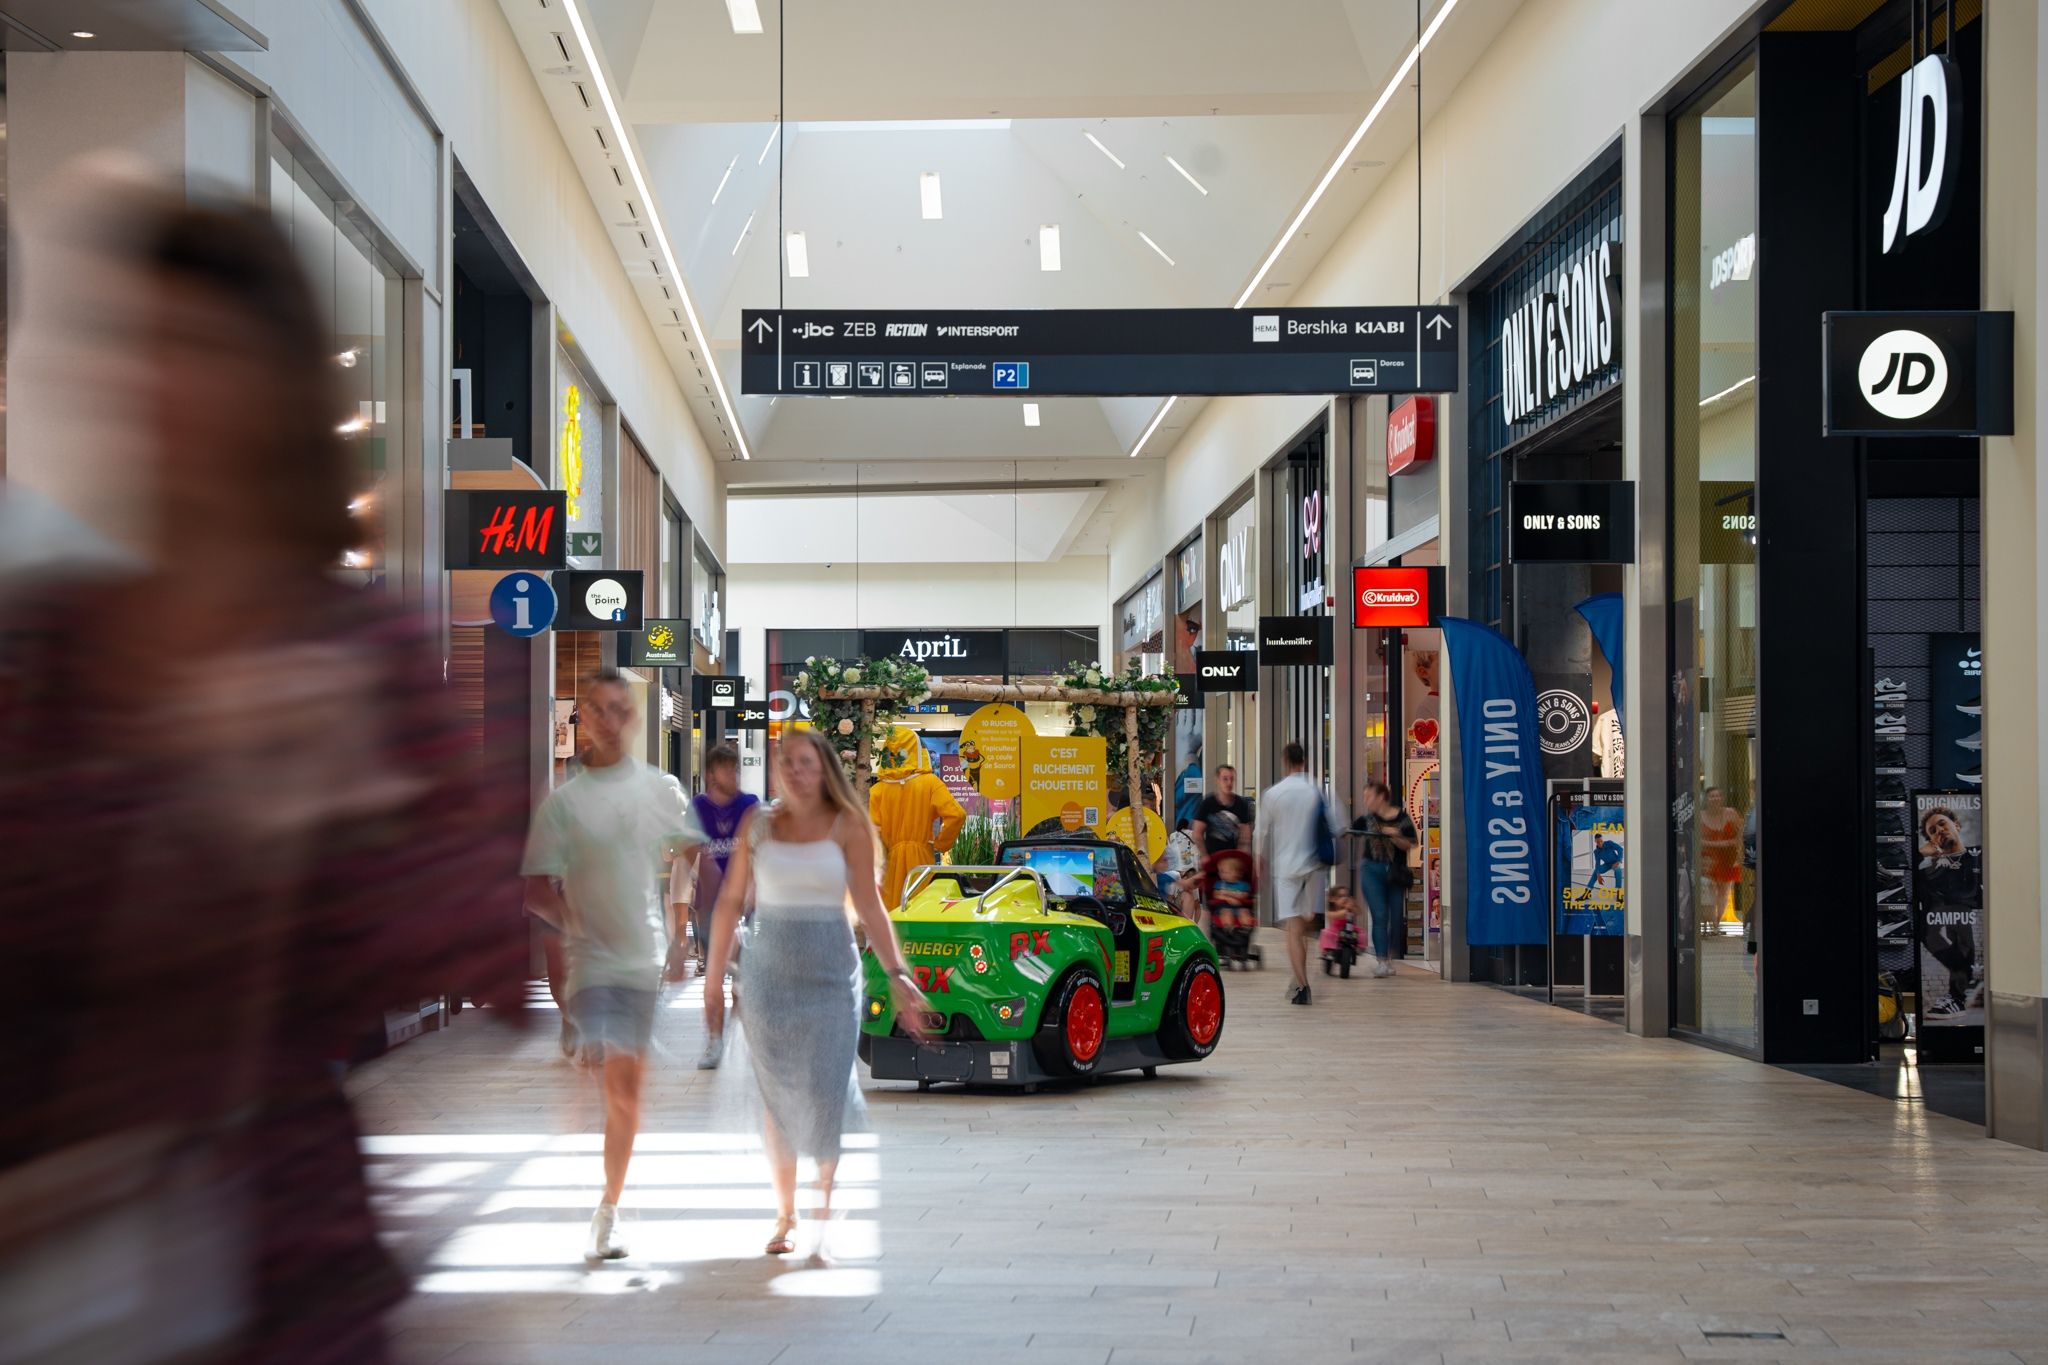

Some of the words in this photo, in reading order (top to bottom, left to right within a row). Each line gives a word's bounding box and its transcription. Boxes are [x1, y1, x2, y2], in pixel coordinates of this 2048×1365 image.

[1882, 54, 1948, 254] JD
[802, 322, 834, 338] jbc
[843, 322, 876, 337] ZEB
[885, 323, 928, 337] ACTION
[948, 326, 1019, 337] INTERSPORT
[1255, 325, 1277, 333] HEMA
[1287, 320, 1347, 335] Bershka
[1355, 321, 1404, 334] KIABI
[951, 362, 986, 371] Esplanade
[1871, 352, 1936, 395] JD
[997, 369, 1015, 382] P2
[1524, 515, 1554, 530] ONLY
[1558, 518, 1565, 530] &
[1567, 515, 1600, 530] SONS
[480, 506, 555, 555] H&M
[1220, 527, 1247, 612] ONLY
[595, 597, 620, 605] point
[1376, 593, 1414, 602] Kruidvat
[1266, 637, 1312, 647] hunkemöller
[1202, 666, 1240, 677] ONLY
[744, 710, 765, 721] jbc
[1553, 698, 1559, 707] &
[1560, 699, 1580, 719] SONS
[1569, 724, 1583, 743] MAKERS
[1050, 747, 1078, 758] C'EST
[1033, 764, 1095, 775] RUCHEMENT
[1030, 780, 1083, 791] CHOUETTE
[1086, 780, 1098, 791] ICI
[1917, 797, 1981, 811] ORIGINALS
[1563, 900, 1585, 910] THE
[1588, 901, 1610, 910] 2ND
[1927, 911, 1977, 925] CAMPUS
[903, 942, 964, 956] ENERGY
[1010, 930, 1053, 960] RX
[1143, 936, 1164, 984] 5
[913, 965, 955, 993] RX
